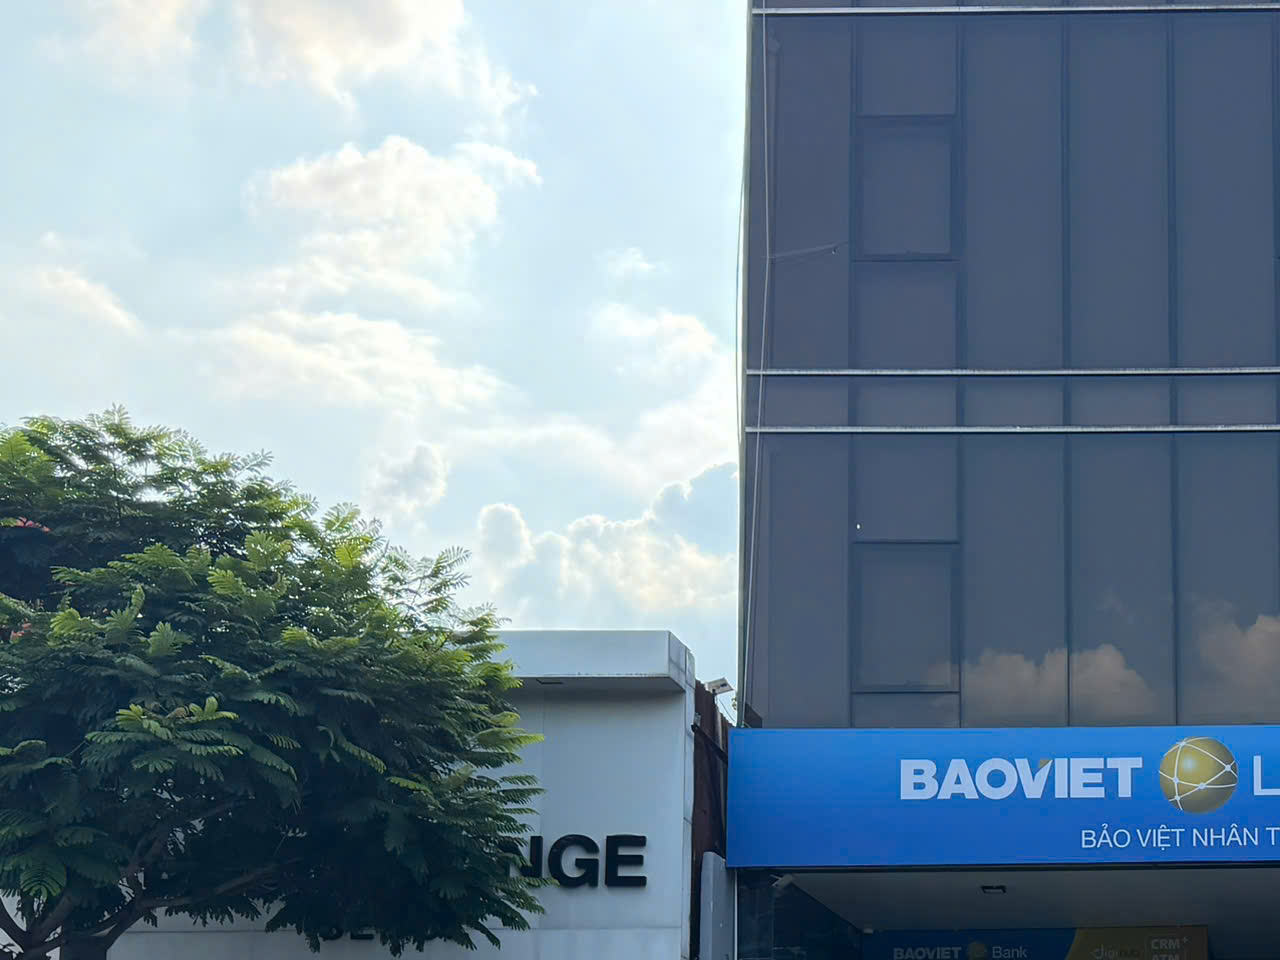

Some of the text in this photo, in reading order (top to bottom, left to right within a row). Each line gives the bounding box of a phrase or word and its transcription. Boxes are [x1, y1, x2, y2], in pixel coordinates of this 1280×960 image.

[899, 757, 1143, 800] BAOVIET
[1080, 823, 1131, 849] BẢO
[1136, 824, 1186, 851] VIỆT
[1191, 823, 1259, 847] NHÂN
[892, 946, 1028, 960] BAOVIET Bank
